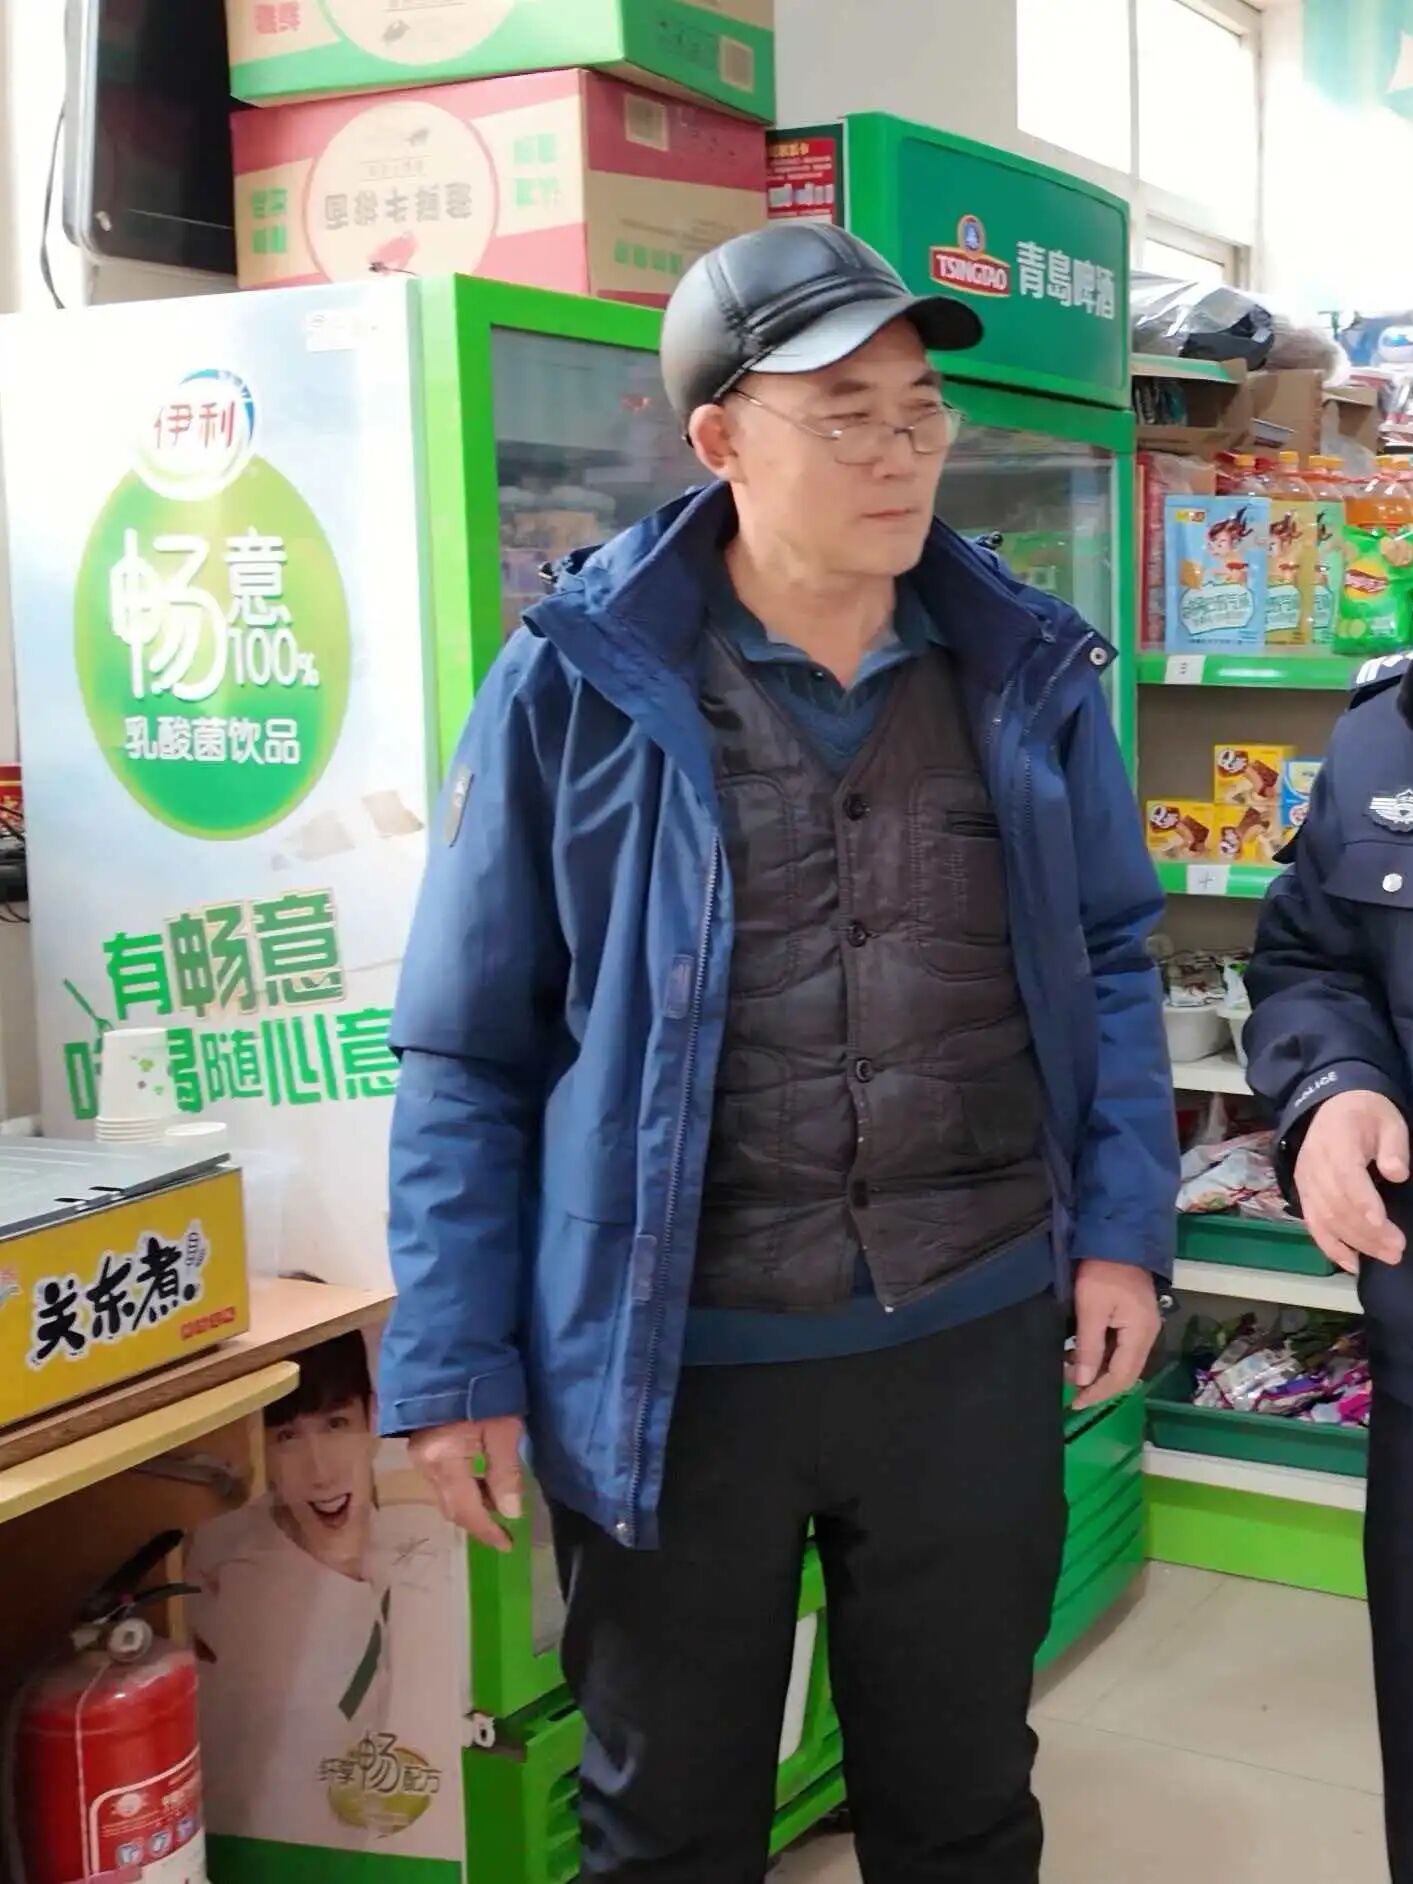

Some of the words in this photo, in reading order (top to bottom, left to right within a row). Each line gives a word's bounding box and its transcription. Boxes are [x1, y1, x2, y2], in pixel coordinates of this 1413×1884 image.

[935, 252, 1008, 292] TSINGTAO
[1015, 240, 1117, 320] 青岛啤酒
[153, 400, 237, 448] 伊利
[109, 526, 291, 702] 畅意
[228, 628, 319, 687] 100%
[123, 715, 302, 766] 乳酸菌饮品
[102, 887, 346, 1021] 有畅意
[36, 1236, 182, 1362] 关东煮
